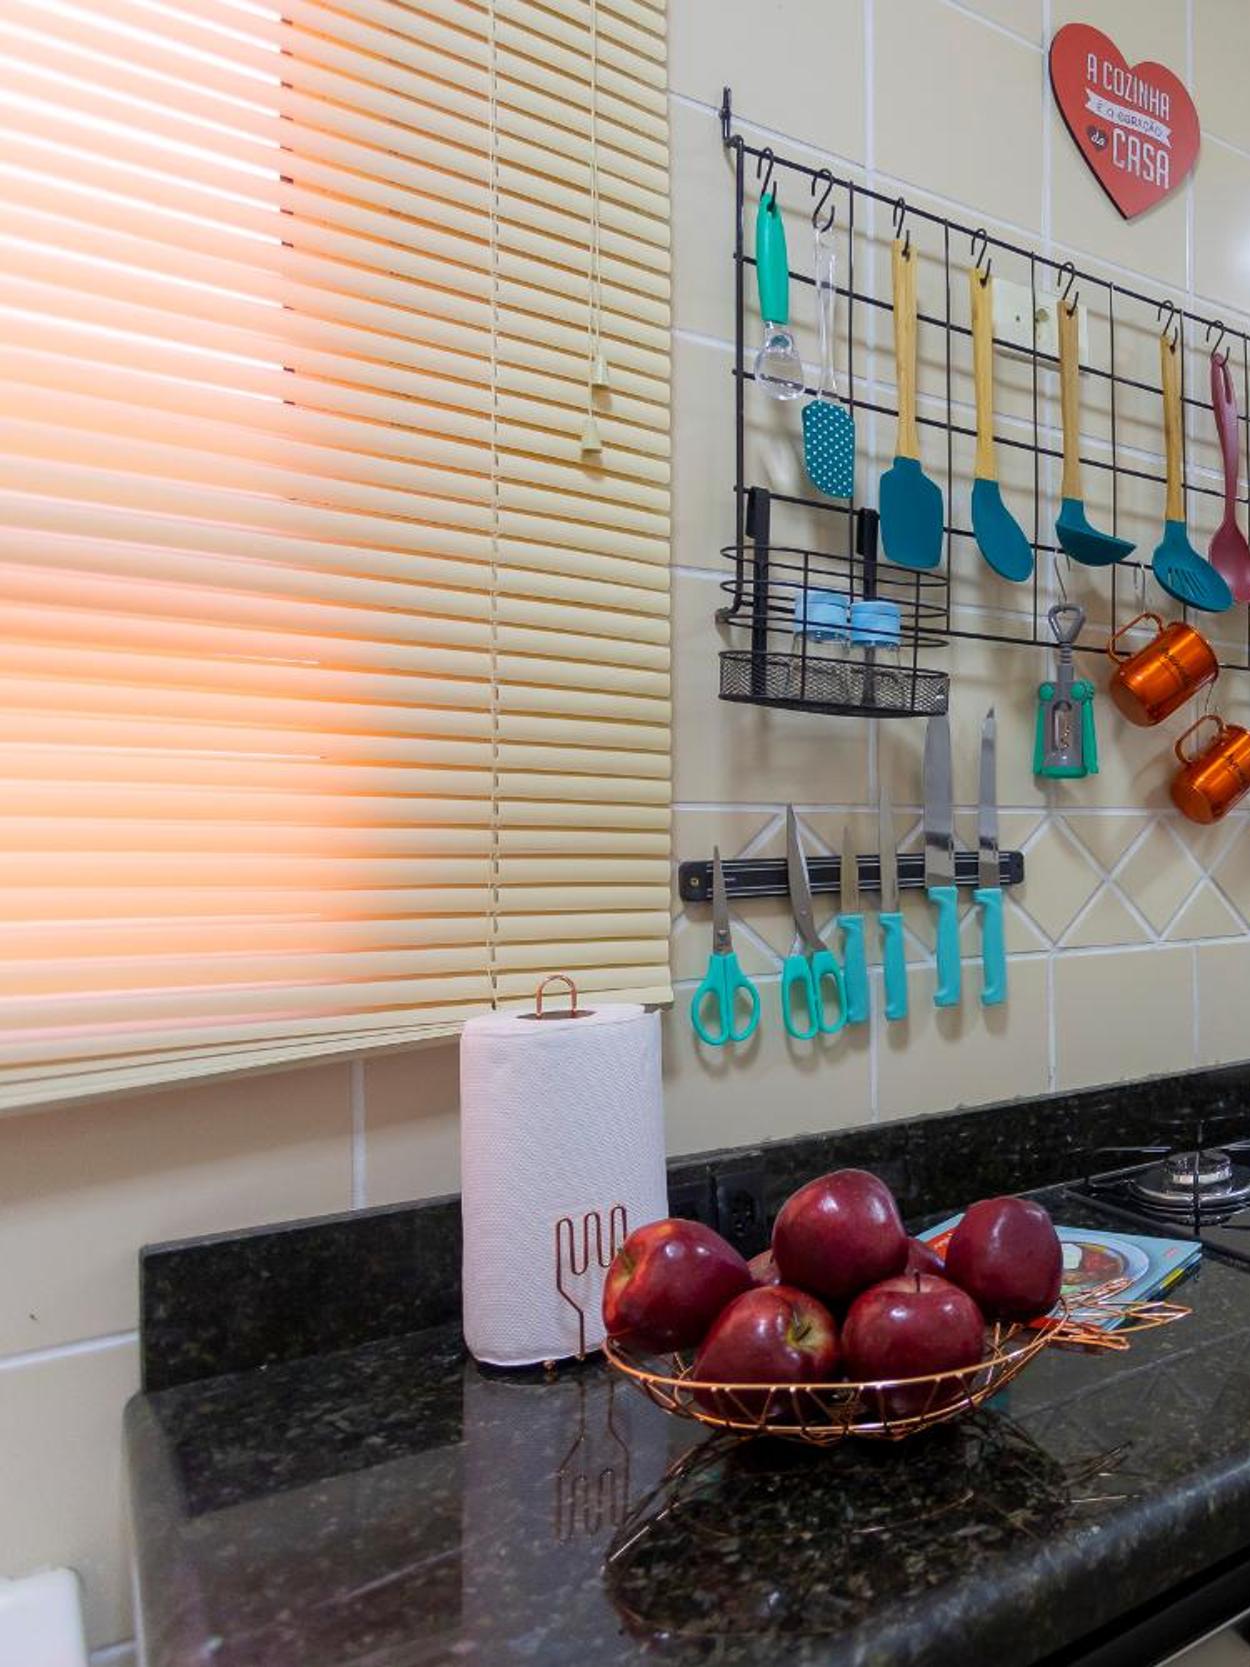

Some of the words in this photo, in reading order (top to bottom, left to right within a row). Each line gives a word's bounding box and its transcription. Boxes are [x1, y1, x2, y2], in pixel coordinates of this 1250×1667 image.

[1087, 53, 1097, 84] A
[1103, 61, 1170, 121] COZINHA
[1112, 128, 1170, 189] CASA
